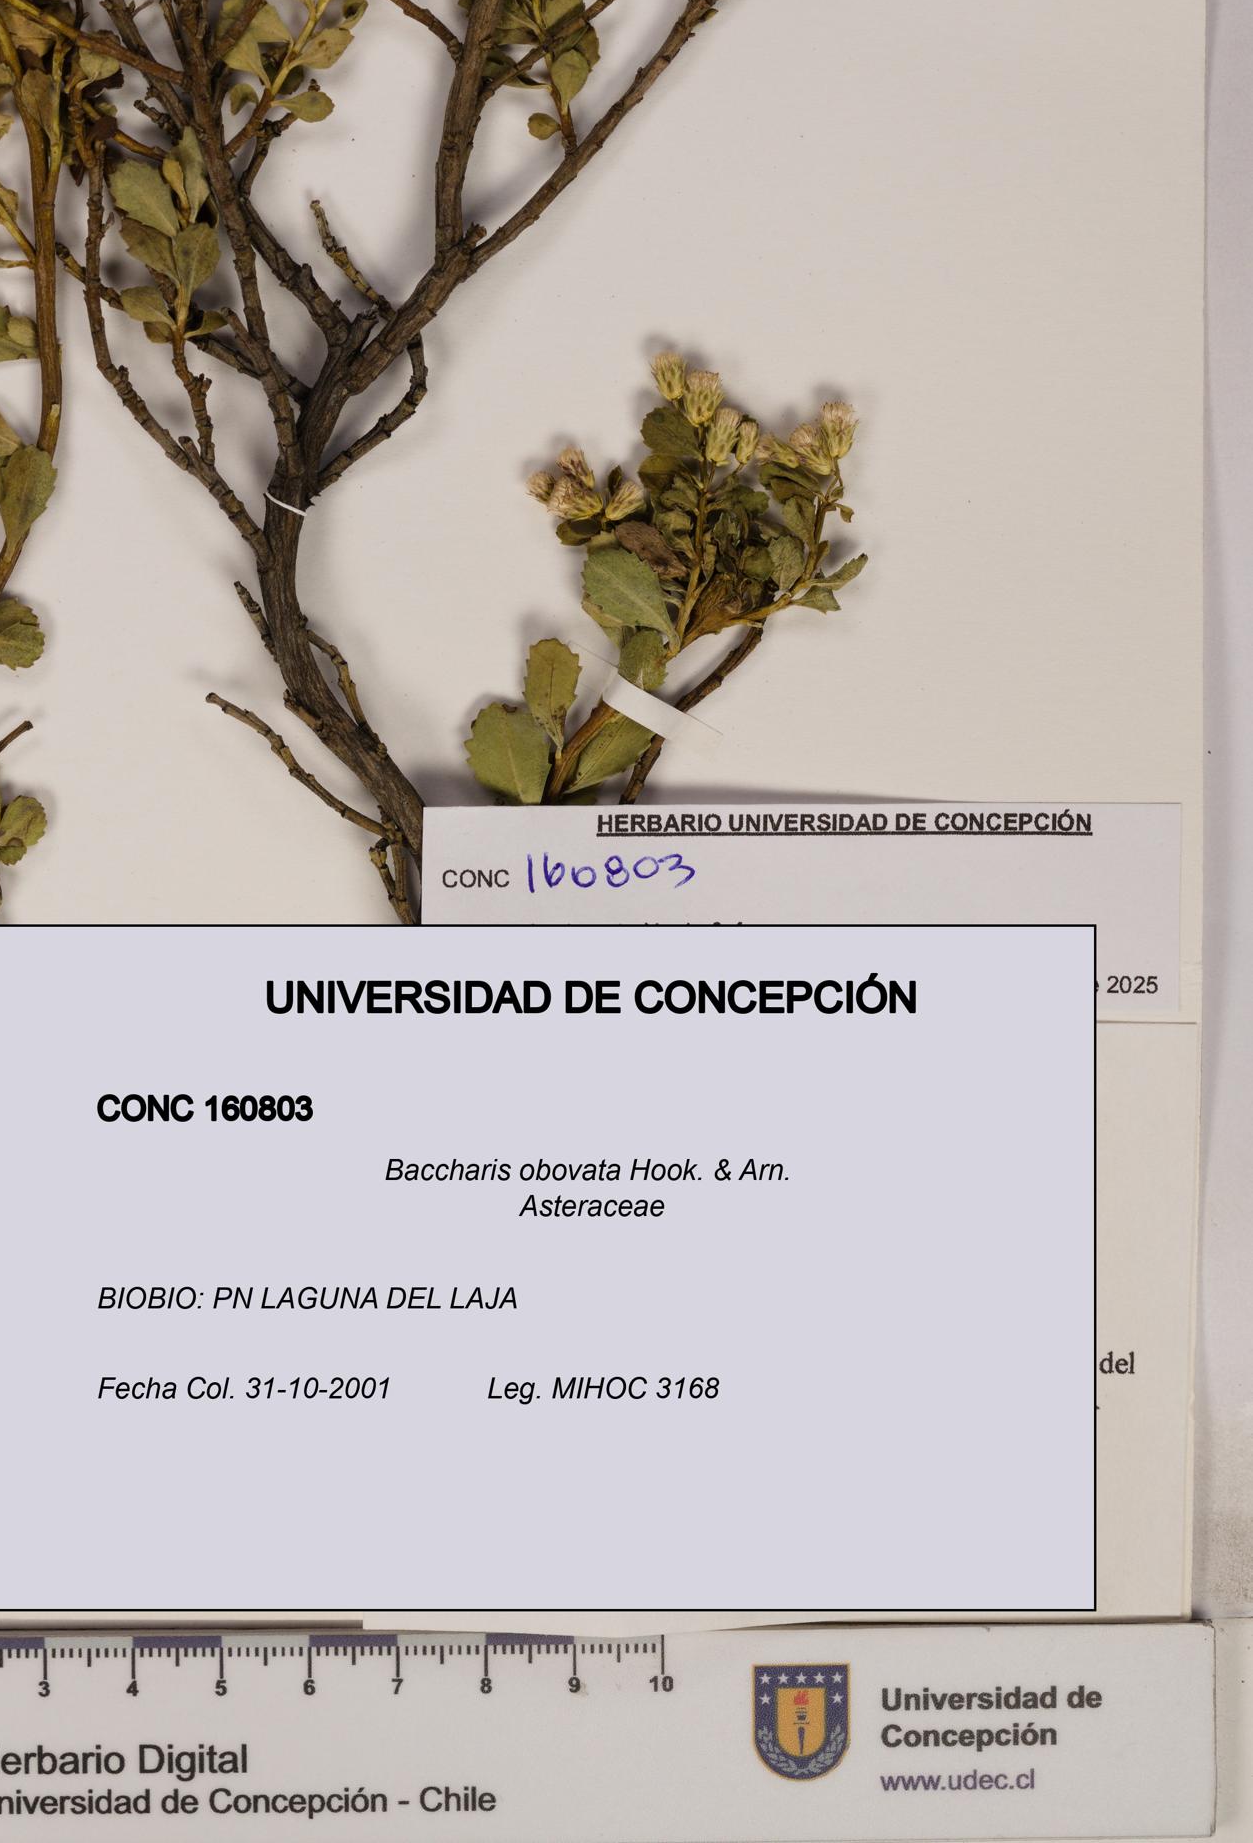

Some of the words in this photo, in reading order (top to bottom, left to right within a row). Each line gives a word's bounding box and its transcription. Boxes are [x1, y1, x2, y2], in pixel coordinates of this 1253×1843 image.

[597, 812, 723, 831] HERBARIO
[728, 812, 889, 831] UNIVERSIDAD
[894, 812, 927, 831] DE
[933, 808, 1092, 831] CONCEPCIÓN
[441, 868, 510, 889] CONC
[526, 852, 696, 894] 160803
[1106, 975, 1159, 995] 2025
[1098, 1350, 1136, 1376] del
[38, 1681, 51, 1698] 3
[126, 1680, 139, 1697] 4
[214, 1679, 228, 1696] 5
[302, 1678, 316, 1695] 6
[391, 1678, 404, 1695] 7
[479, 1677, 493, 1694] 8
[567, 1676, 581, 1693] 9
[648, 1675, 674, 1692] 10
[881, 1685, 1058, 1712] Universidad
[1066, 1684, 1103, 1710] de
[880, 1721, 1058, 1753] Concepción
[138, 1743, 248, 1782] Digital
[879, 1767, 1035, 1792] www.udec.cl
[160, 1787, 200, 1815] de
[208, 1786, 388, 1819] Concepción
[418, 1785, 497, 1813] Chile
